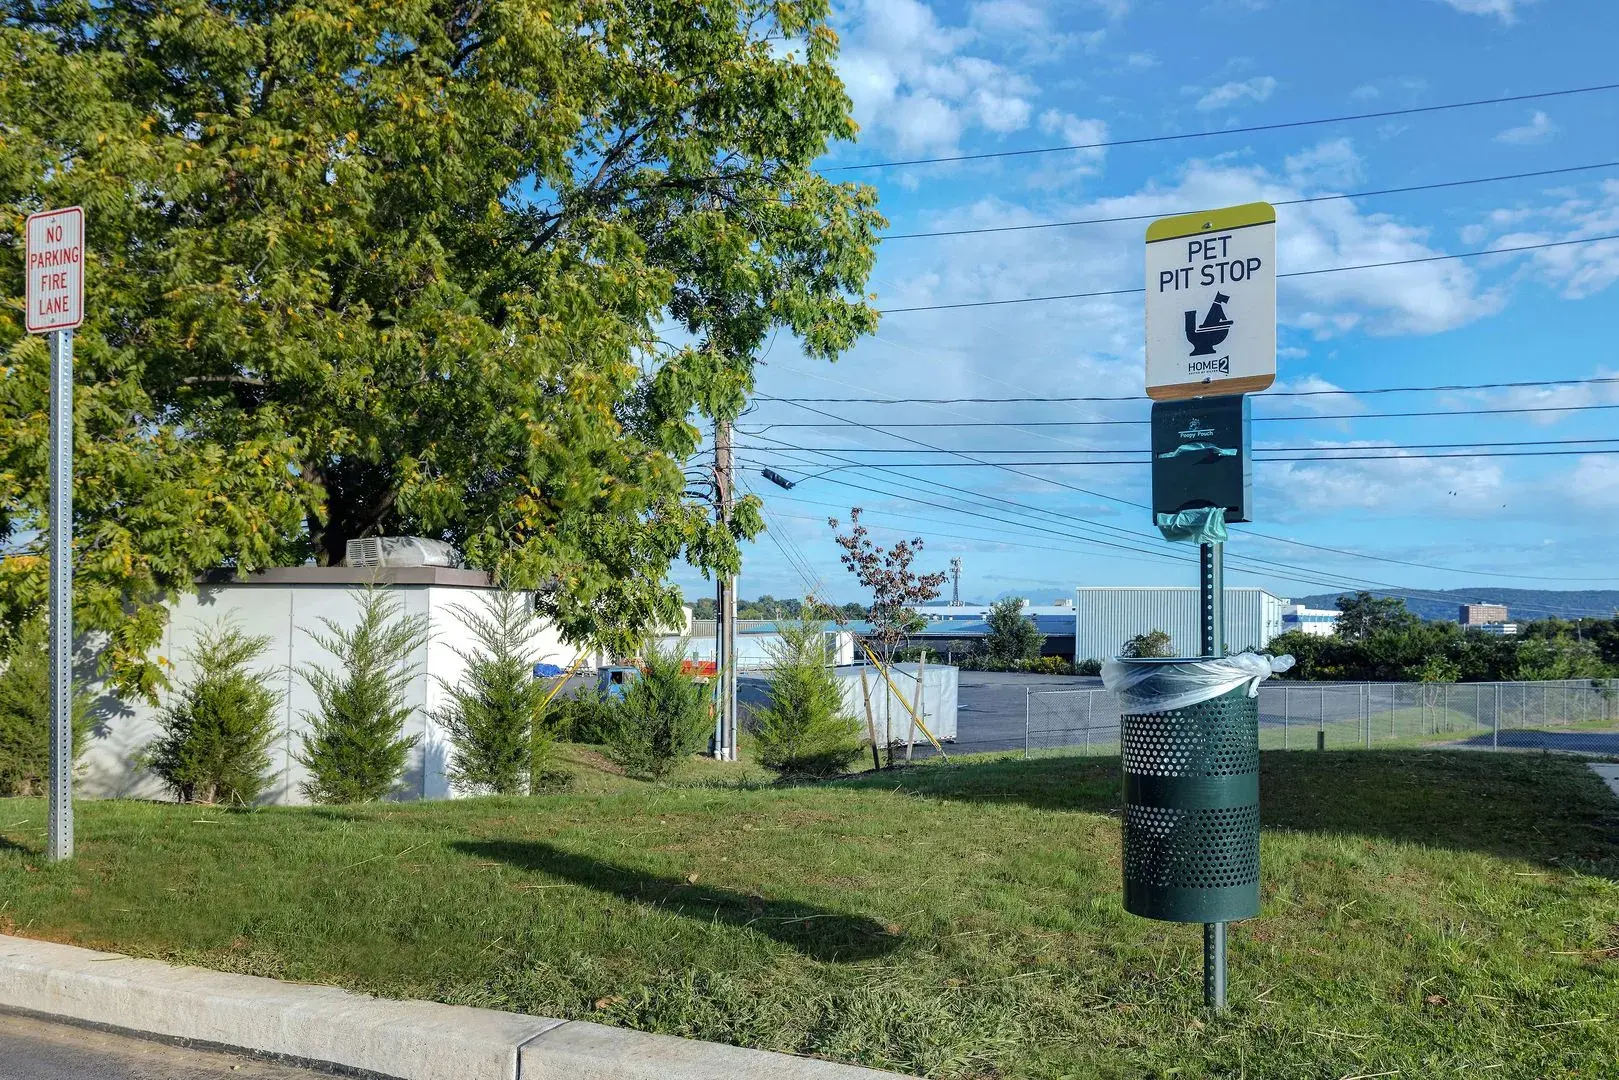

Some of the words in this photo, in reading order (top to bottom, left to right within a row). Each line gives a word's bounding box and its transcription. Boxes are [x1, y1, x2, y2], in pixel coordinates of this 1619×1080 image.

[46, 225, 63, 243] NO
[30, 246, 79, 270] PARKING
[1188, 235, 1232, 262] PET
[41, 272, 67, 292] FIRE
[1160, 267, 1194, 292] PIT
[1200, 257, 1261, 286] STOP
[39, 296, 69, 316] LANE
